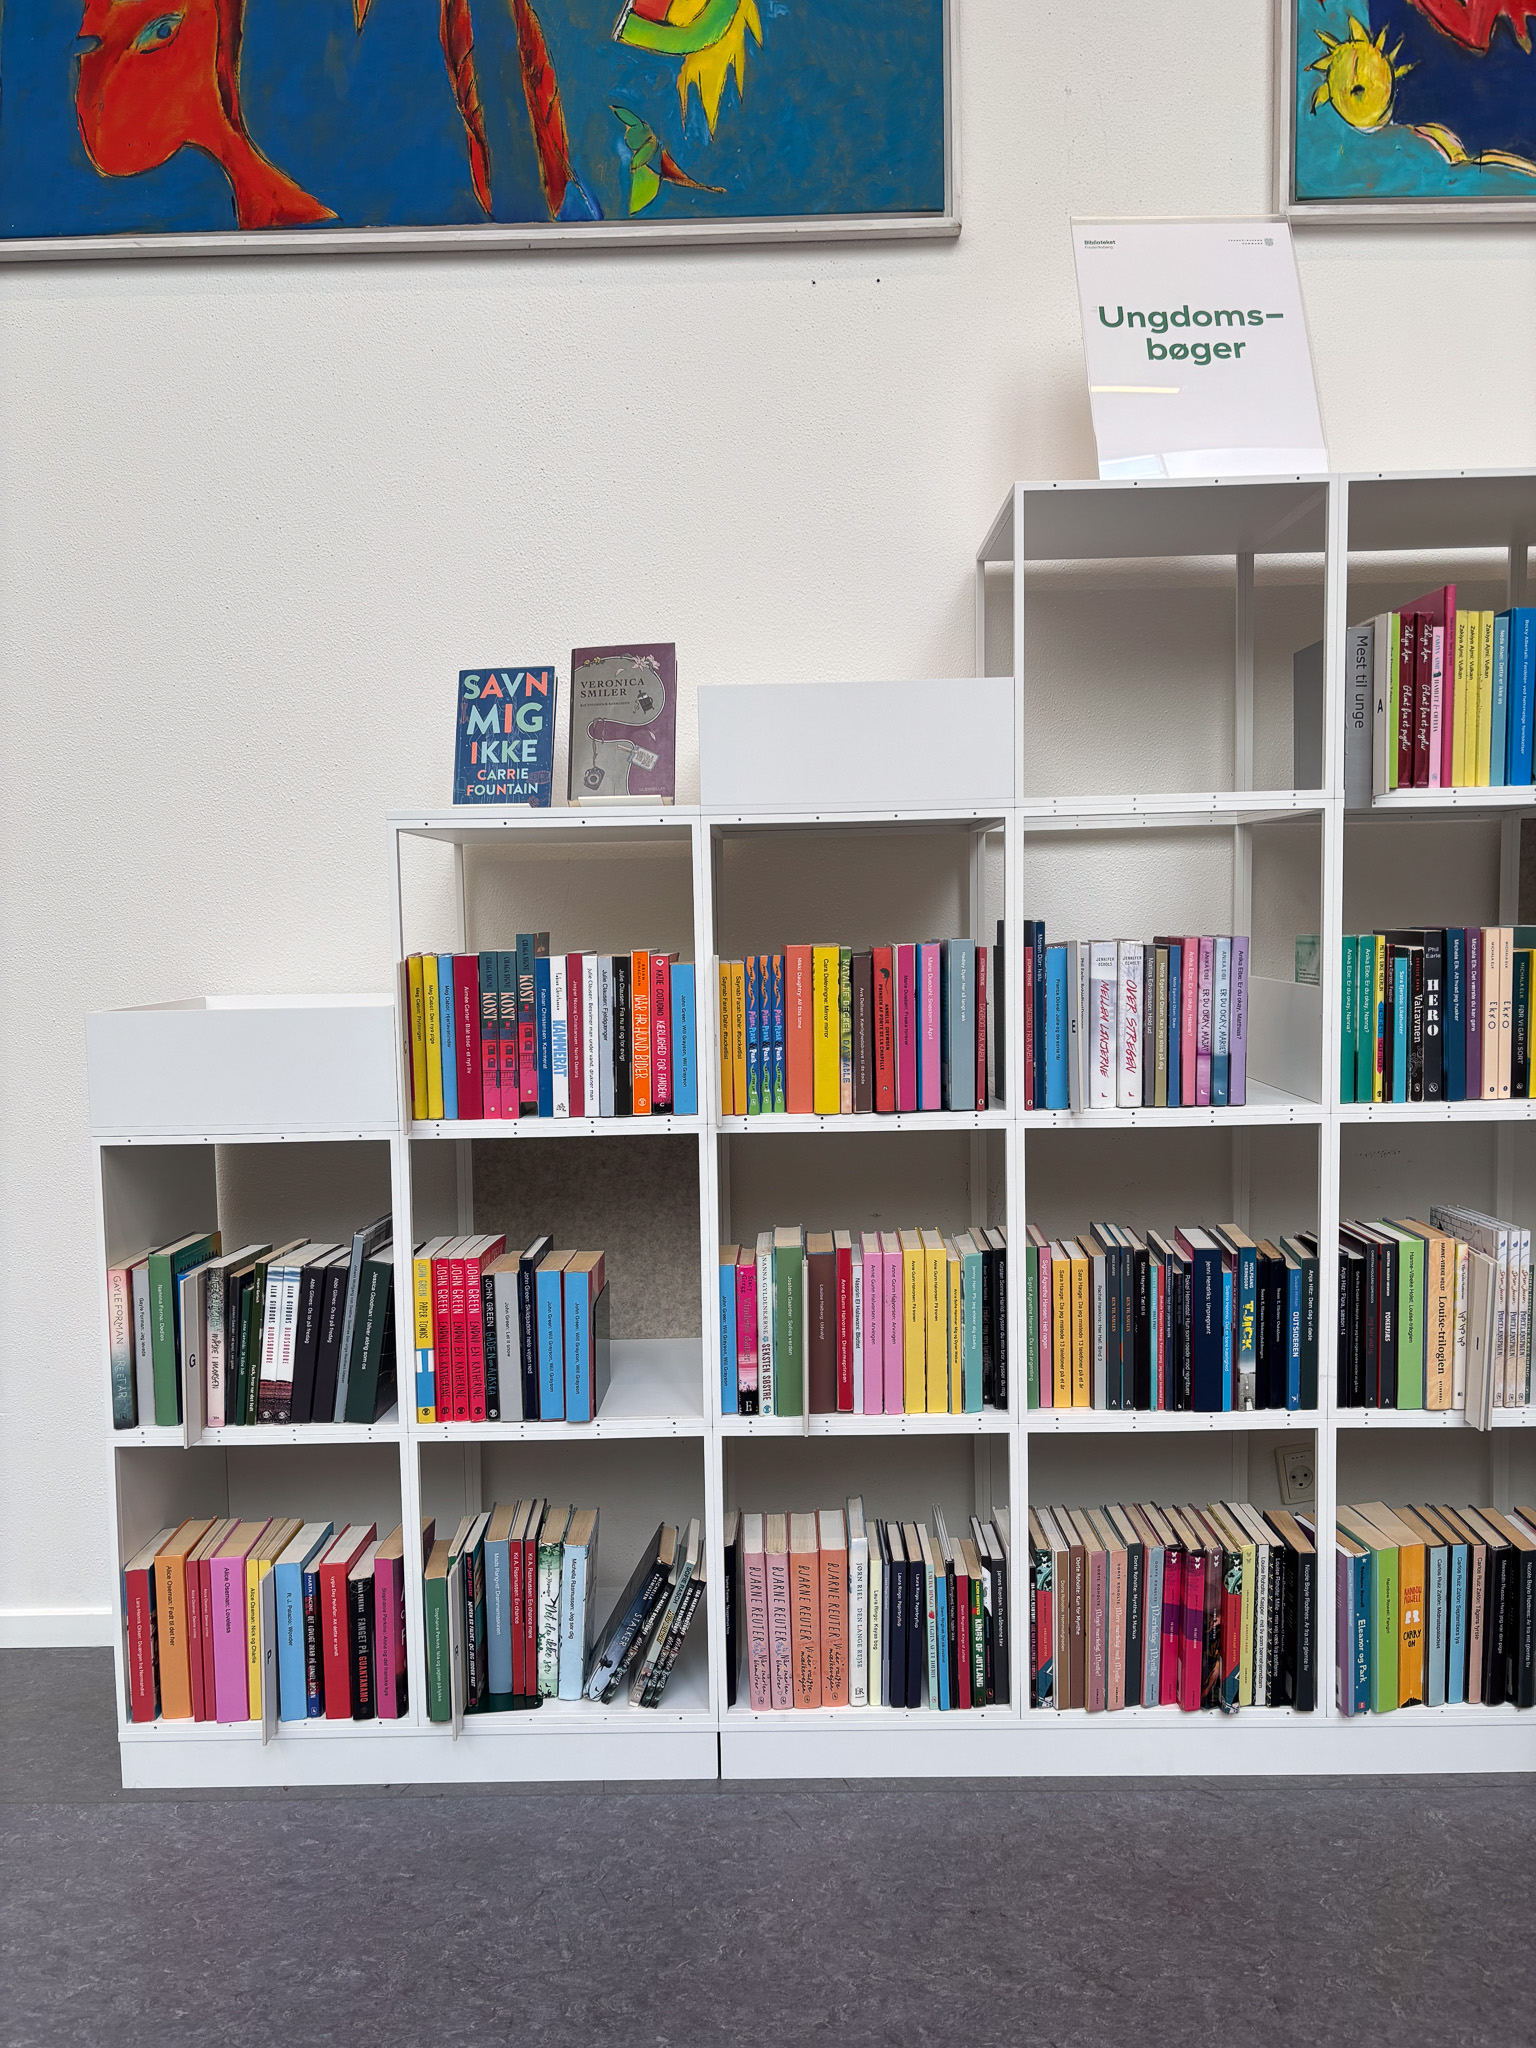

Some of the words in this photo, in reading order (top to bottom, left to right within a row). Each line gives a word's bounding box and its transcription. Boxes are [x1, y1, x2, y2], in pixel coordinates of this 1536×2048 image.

[1099, 305, 1283, 333] Ungdoms-
[1147, 338, 1246, 365] bøger
[1356, 636, 1368, 669] Mest
[464, 672, 548, 699] SAVN
[581, 678, 645, 688] VERONICA
[581, 689, 627, 698] SMILER
[1355, 675, 1367, 687] til
[1353, 694, 1365, 728] unge
[1377, 699, 1383, 713] A
[467, 703, 543, 735] MIG
[471, 740, 537, 764] IKKE
[477, 768, 528, 781] CARRIE
[467, 783, 538, 796] FOUNTAIN
[519, 975, 533, 1003] KOST
[655, 970, 663, 985] KATIE
[483, 992, 497, 1020] KOST
[500, 992, 515, 1020] KOST
[634, 995, 649, 1011] NÅR
[656, 989, 664, 1016] COTUGNO
[1100, 980, 1109, 1022] MELLEM
[1126, 980, 1137, 1013] OVER
[1220, 998, 1226, 1007] DU
[1427, 979, 1439, 1036] HERO
[634, 1014, 647, 1026] HR.
[1218, 1009, 1226, 1030] OKAY,
[1414, 994, 1422, 1043] Valravnen
[553, 1020, 566, 1077] KAMMERAT
[634, 1027, 649, 1051] HUND
[657, 1021, 667, 1055] KÆRLIGHED
[1126, 1018, 1136, 1073] STREGEN
[1219, 1031, 1227, 1054] MARIE?
[1100, 1024, 1109, 1078] LINJERNE
[635, 1055, 648, 1079] BIDER
[658, 1059, 666, 1070] FOR
[418, 1263, 427, 1278] JOHN
[437, 1264, 446, 1286] JOHN
[419, 1281, 427, 1296] GREEN
[368, 1292, 376, 1318] Goodman:
[419, 1302, 427, 1318] PAPER
[438, 1289, 447, 1314] GREEN
[419, 1321, 428, 1339] TOWNS
[439, 1322, 448, 1343] ENDNU
[1436, 1296, 1447, 1374] Louise-trilogien
[189, 1354, 196, 1367] G
[439, 1348, 449, 1357] EN
[762, 1344, 771, 1373] SEKSTEN
[440, 1362, 450, 1399] KATHERINE
[762, 1376, 771, 1400] SØSTRE
[749, 1567, 762, 1603] BJARNE
[827, 1563, 840, 1599] BJARNE
[357, 1618, 366, 1643] FANGET
[619, 1613, 642, 1647] STALKER
[751, 1607, 765, 1642] REUTER
[828, 1603, 841, 1637] REUTER
[975, 1619, 983, 1641] KINGS
[976, 1643, 983, 1652] OF
[1357, 1619, 1366, 1651] Eleanor
[358, 1646, 368, 1654] PÅ
[1357, 1653, 1364, 1663] og
[359, 1656, 368, 1702] GUANTANAMO
[1358, 1665, 1366, 1683] Park
